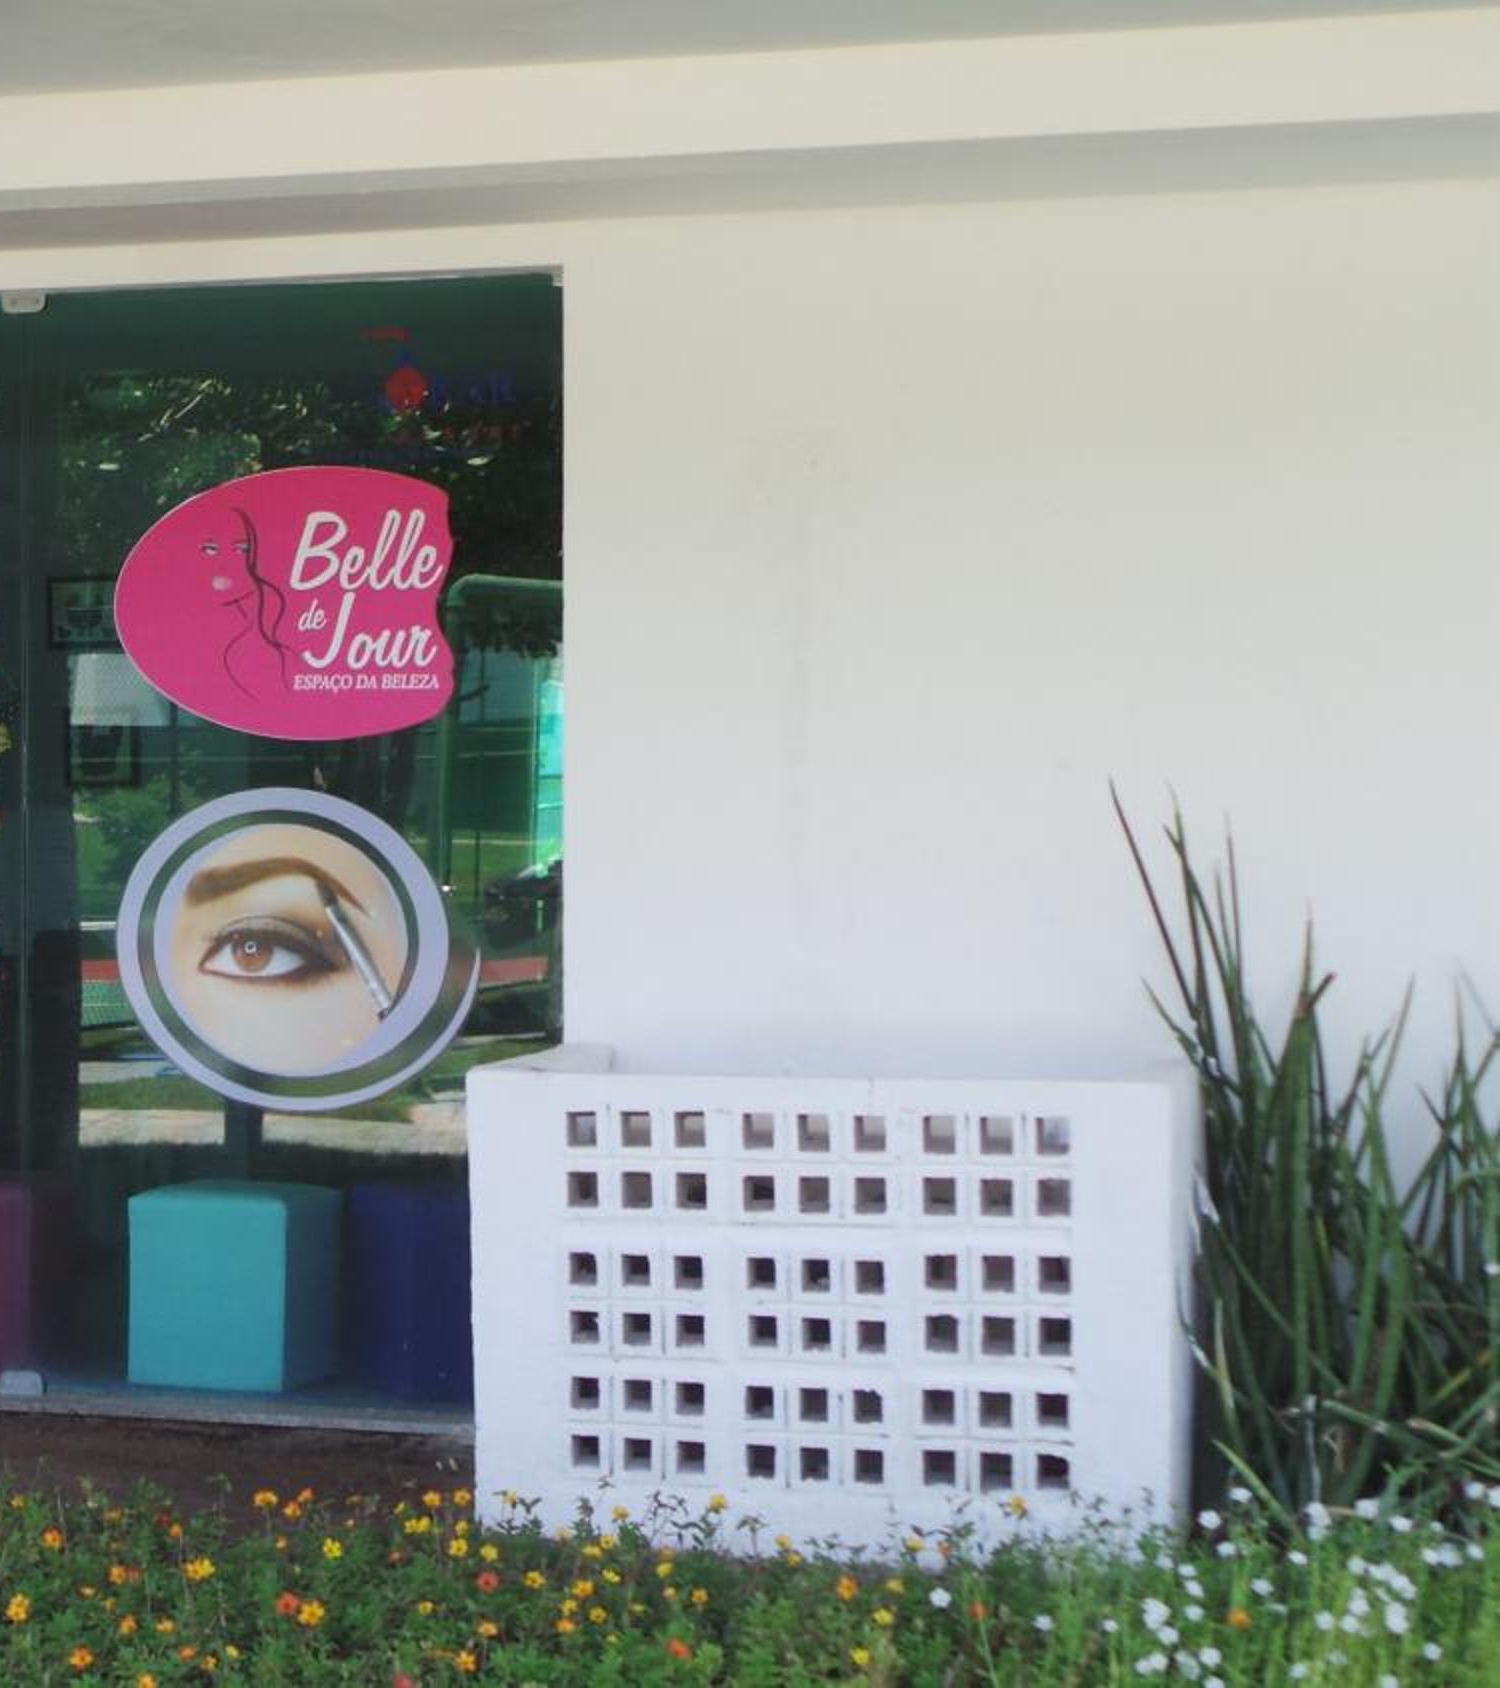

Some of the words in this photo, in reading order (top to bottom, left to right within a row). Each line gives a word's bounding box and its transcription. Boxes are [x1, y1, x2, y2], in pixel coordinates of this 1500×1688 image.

[290, 509, 443, 590] Belle
[298, 598, 327, 631] de
[303, 591, 438, 669] Jour
[293, 674, 352, 694] ESPAÇO
[356, 675, 377, 690] DA
[381, 674, 440, 690] BELEZA
